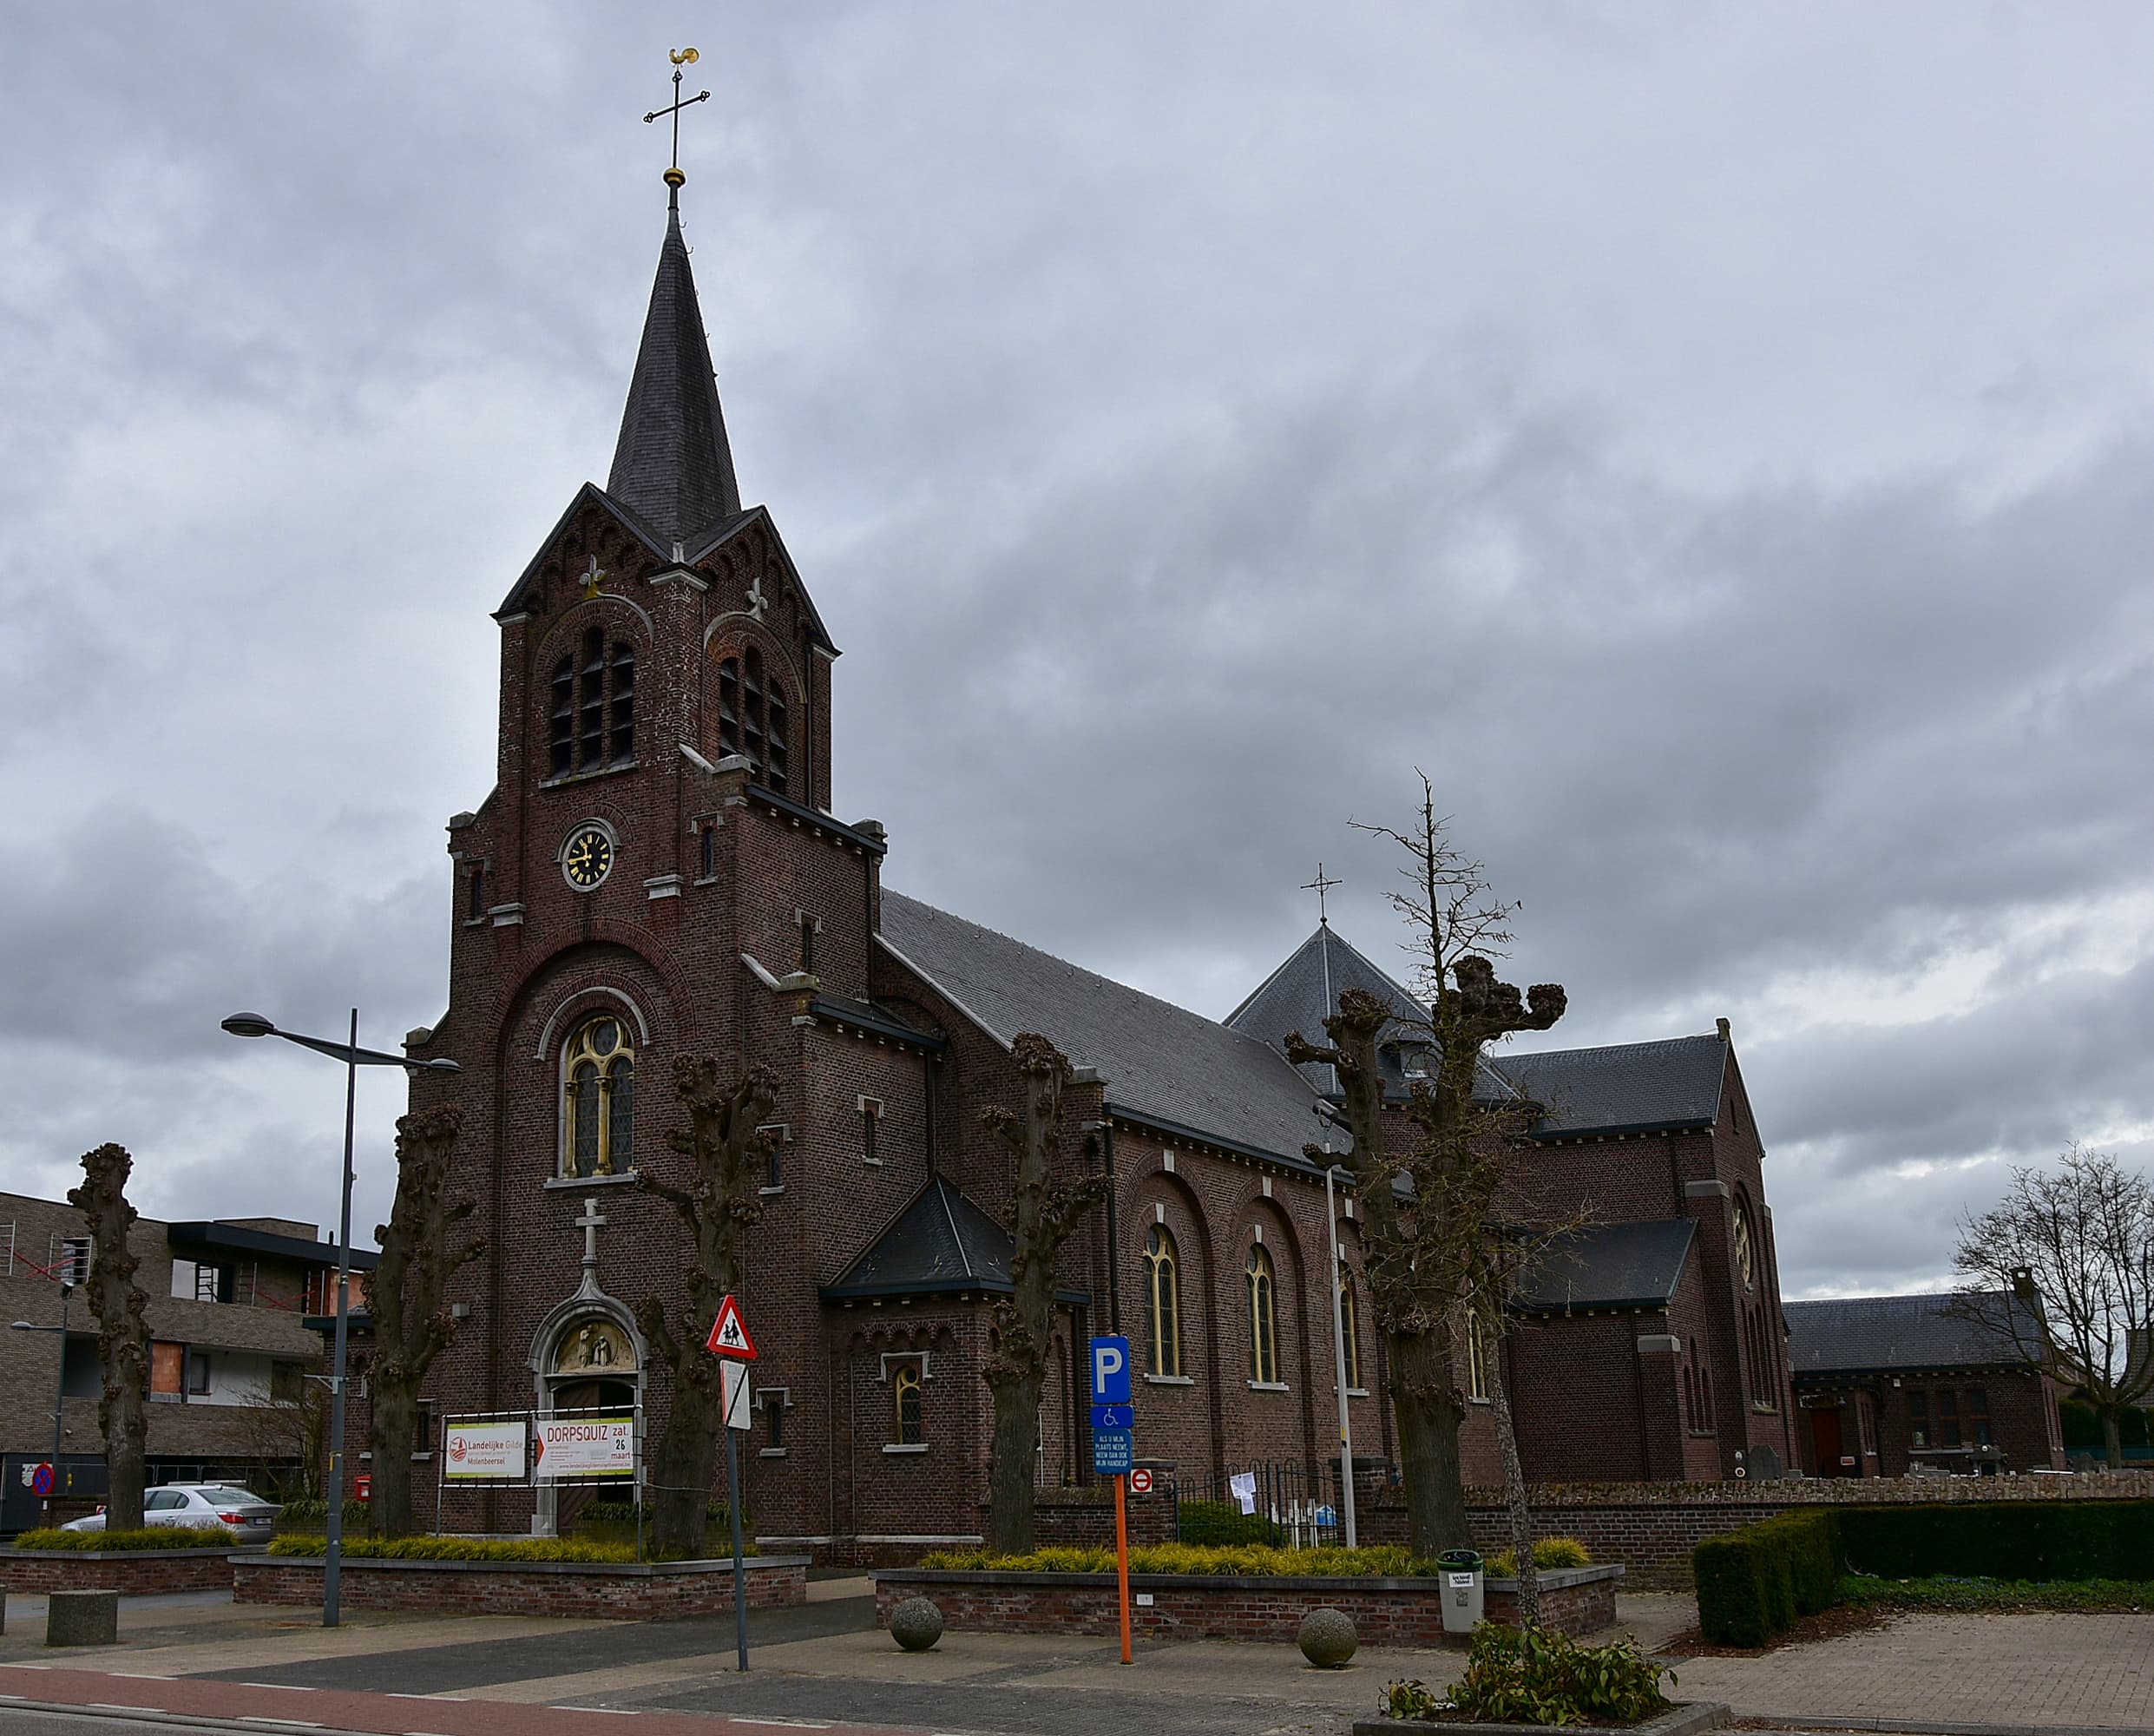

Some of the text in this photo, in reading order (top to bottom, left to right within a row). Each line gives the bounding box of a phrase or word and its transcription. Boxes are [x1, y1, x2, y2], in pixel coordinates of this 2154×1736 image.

[1096, 1347, 1122, 1393] P
[548, 1425, 607, 1442] DORPSQUIZ
[613, 1425, 628, 1436] zat.
[469, 1441, 503, 1450] Landelijke
[616, 1439, 625, 1450] 26
